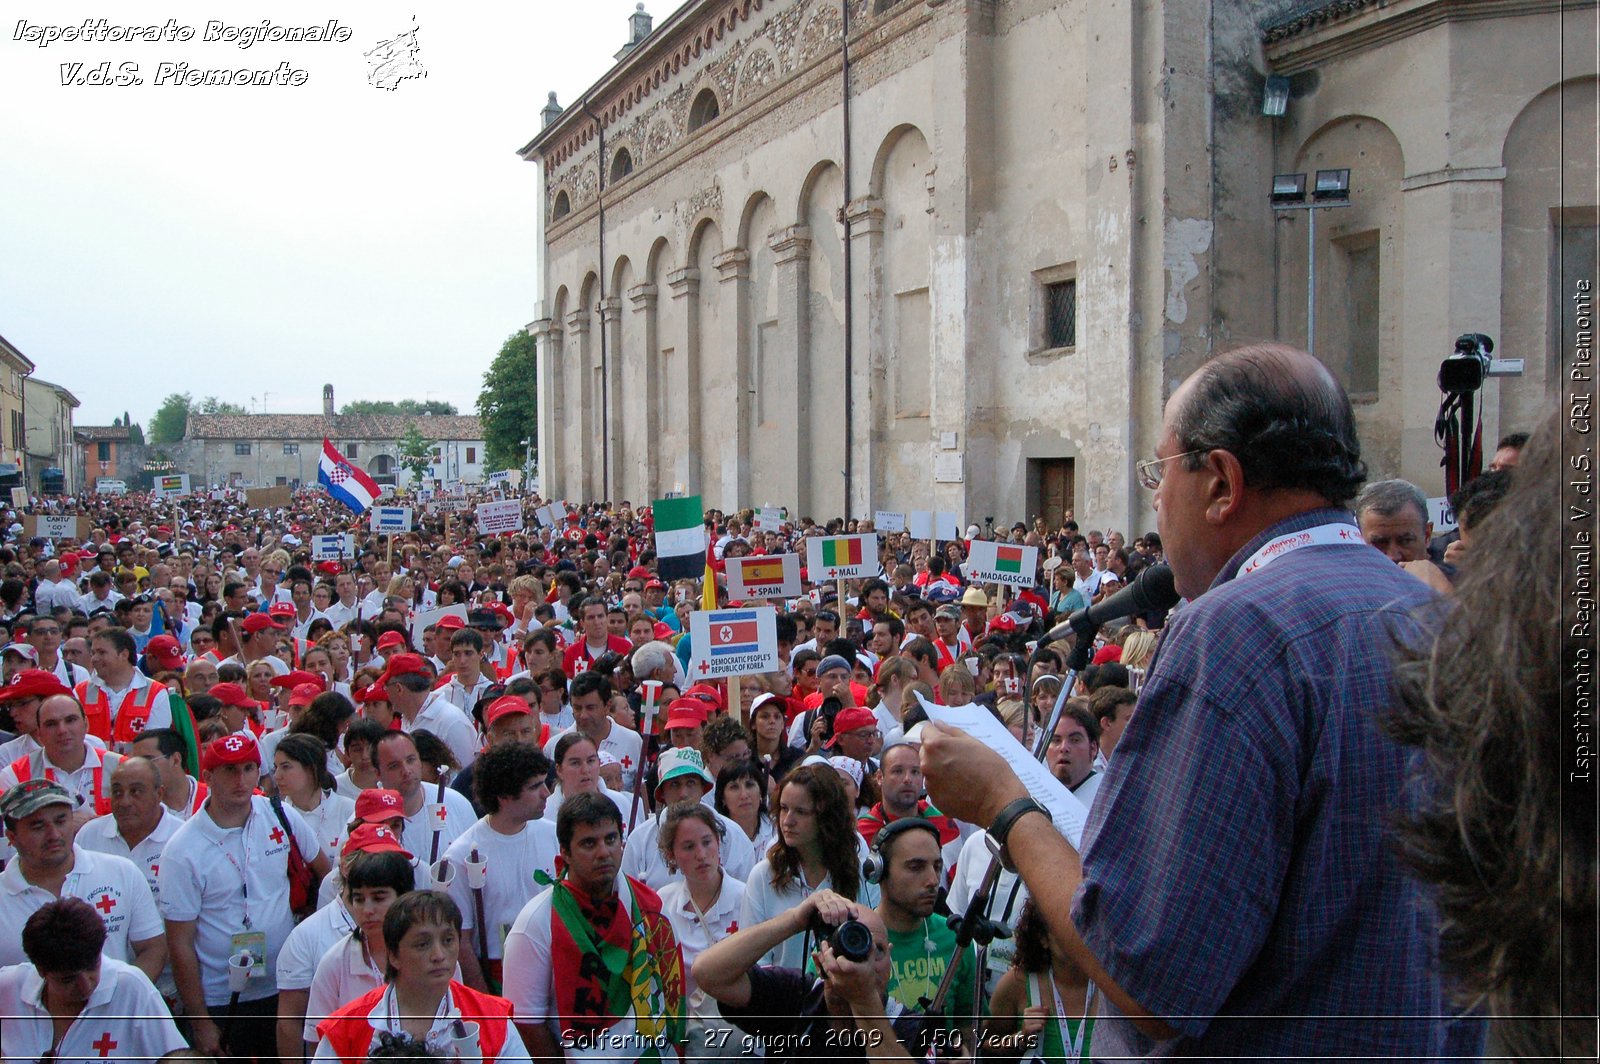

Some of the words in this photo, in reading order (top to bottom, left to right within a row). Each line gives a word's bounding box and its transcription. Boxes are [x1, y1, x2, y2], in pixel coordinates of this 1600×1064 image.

[1261, 537, 1297, 557] solferino
[838, 567, 858, 577] MALI
[980, 571, 1032, 585] MADAGASCAR
[757, 586, 782, 596] SPAIN
[710, 655, 746, 666] DEMOCRATIC
[747, 653, 771, 663] PEOPLE'S
[711, 664, 738, 674] REPUBLIC
[738, 663, 745, 671] OF
[747, 661, 765, 670] KOREA
[889, 956, 946, 981] LCOM
